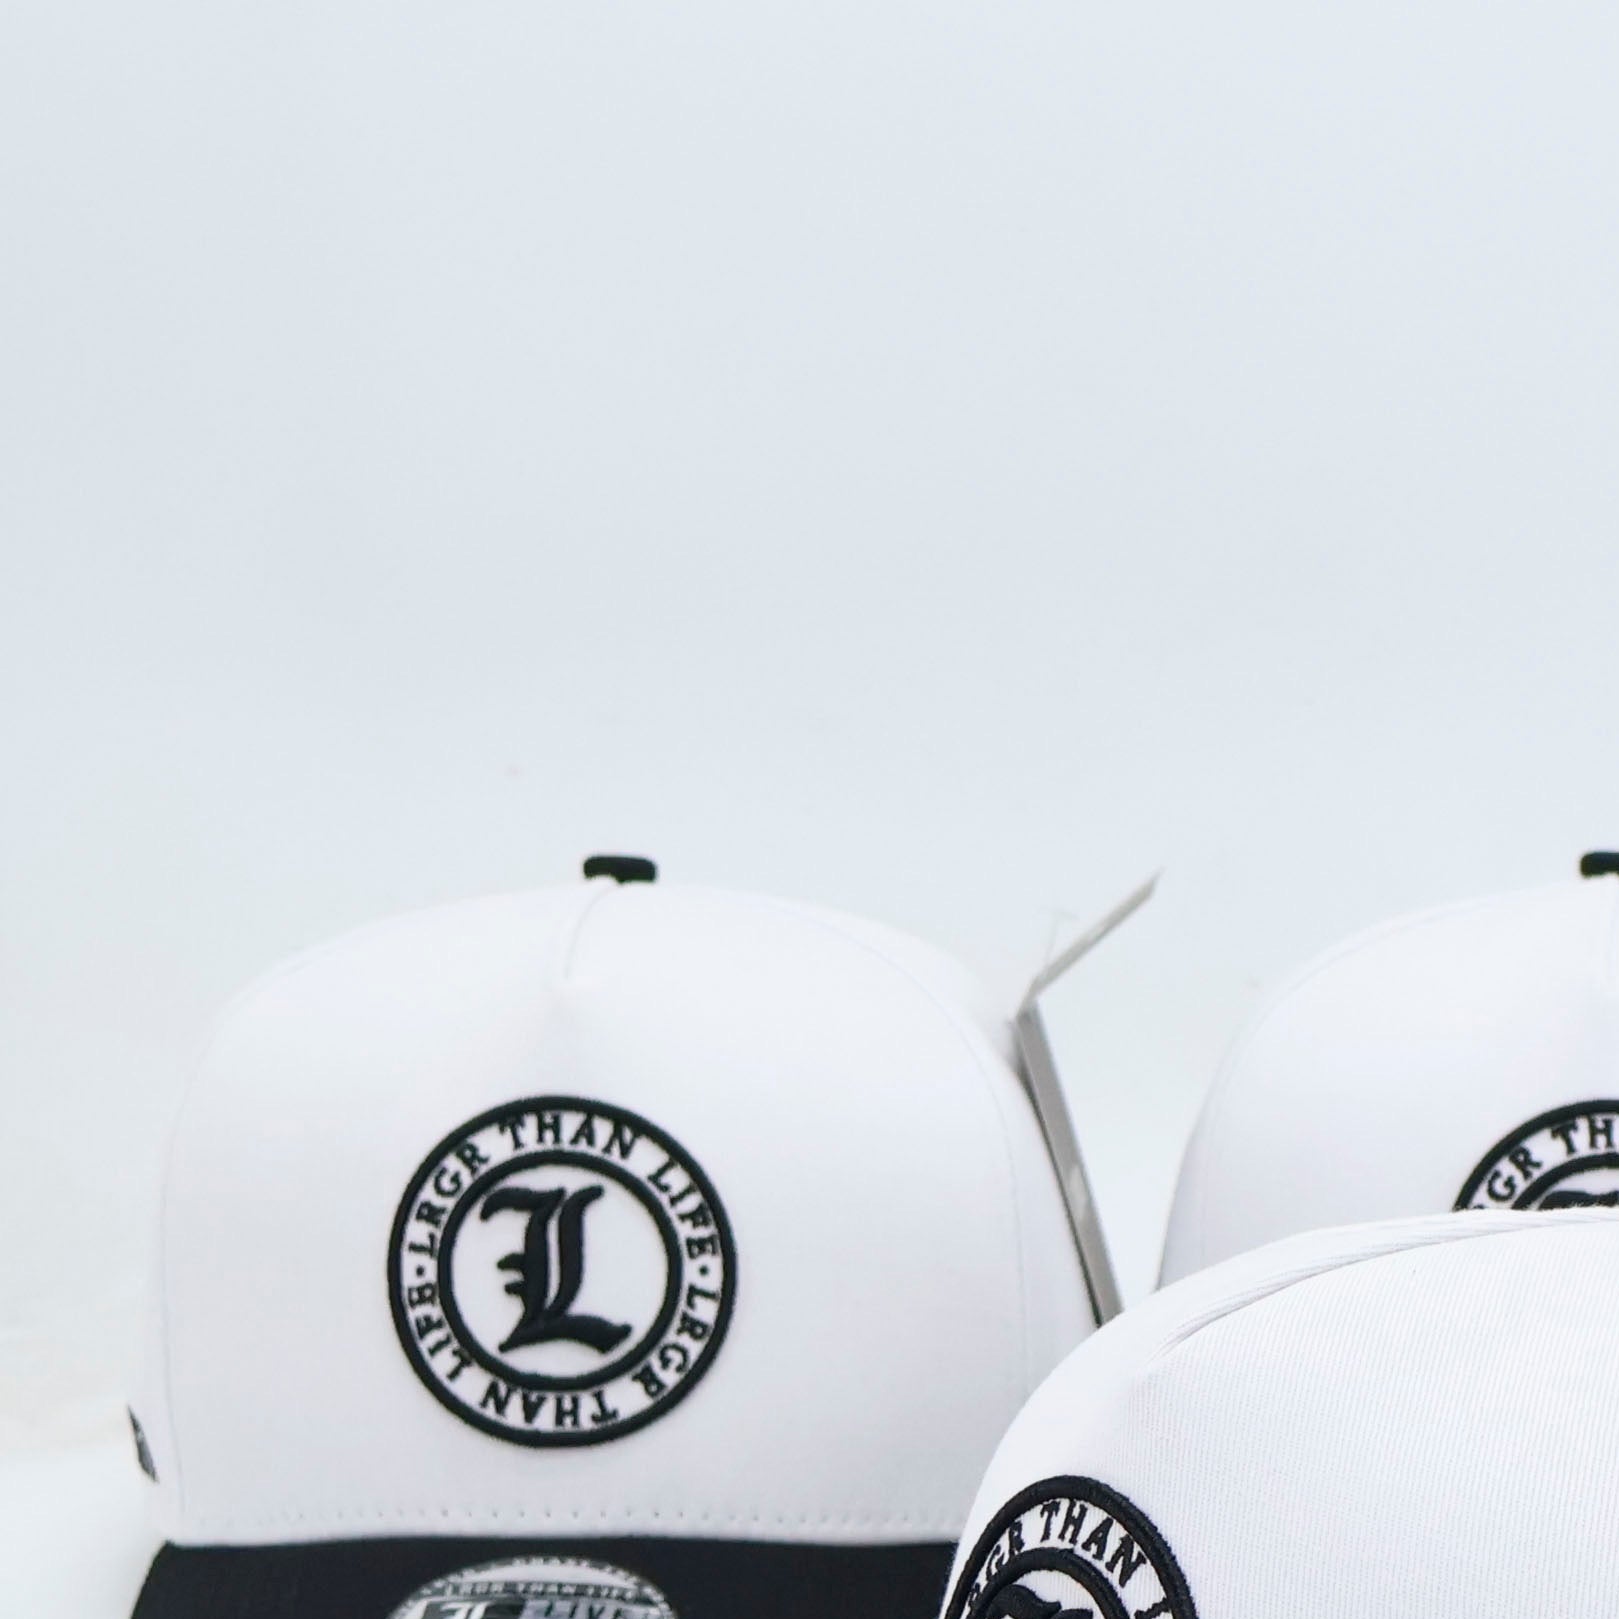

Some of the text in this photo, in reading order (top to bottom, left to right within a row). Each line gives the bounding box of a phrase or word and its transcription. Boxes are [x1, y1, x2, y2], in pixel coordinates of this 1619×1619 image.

[409, 1111, 719, 1259] LRGR THAN LIFE
[407, 1282, 719, 1427] LRGR THAN LIFE
[1040, 1499, 1147, 1588] THAN
